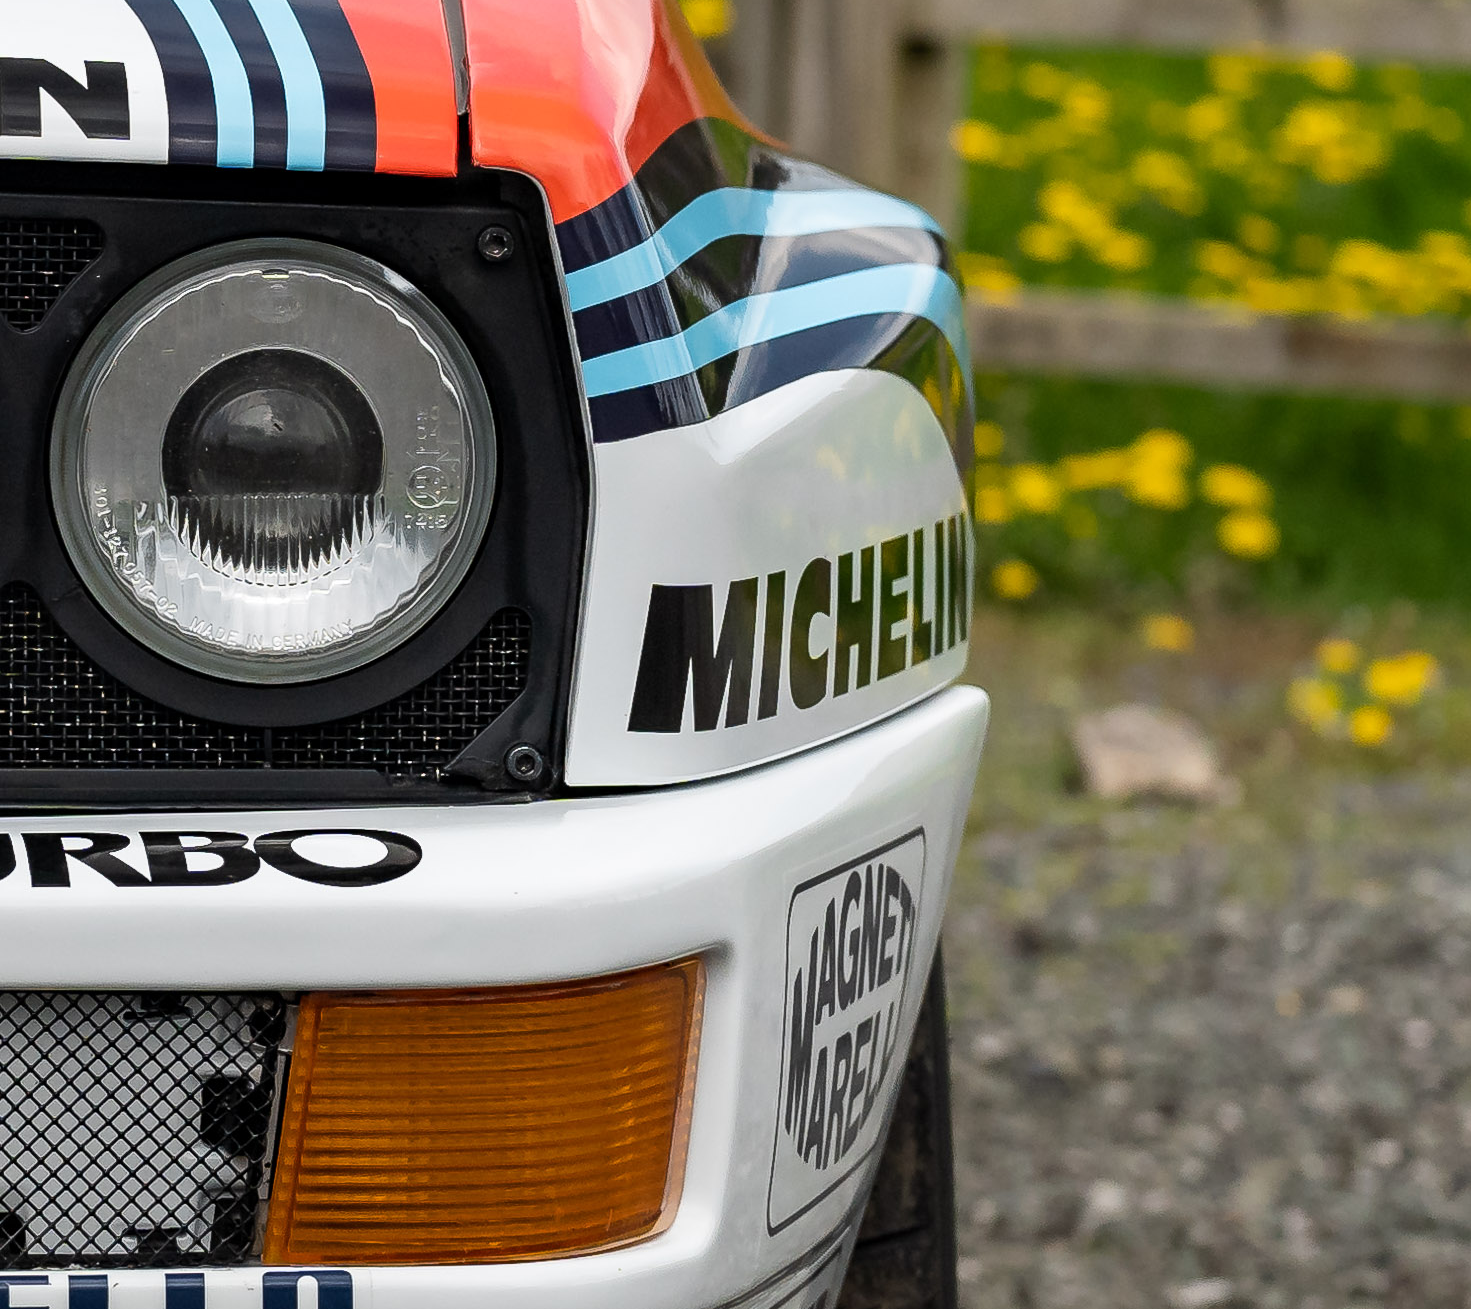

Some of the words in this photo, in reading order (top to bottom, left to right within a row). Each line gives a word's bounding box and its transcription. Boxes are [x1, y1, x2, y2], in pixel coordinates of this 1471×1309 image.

[187, 616, 239, 646] MADE
[246, 633, 263, 650] IN
[272, 619, 354, 650] GERMANY
[627, 512, 967, 733] MICHELIN
